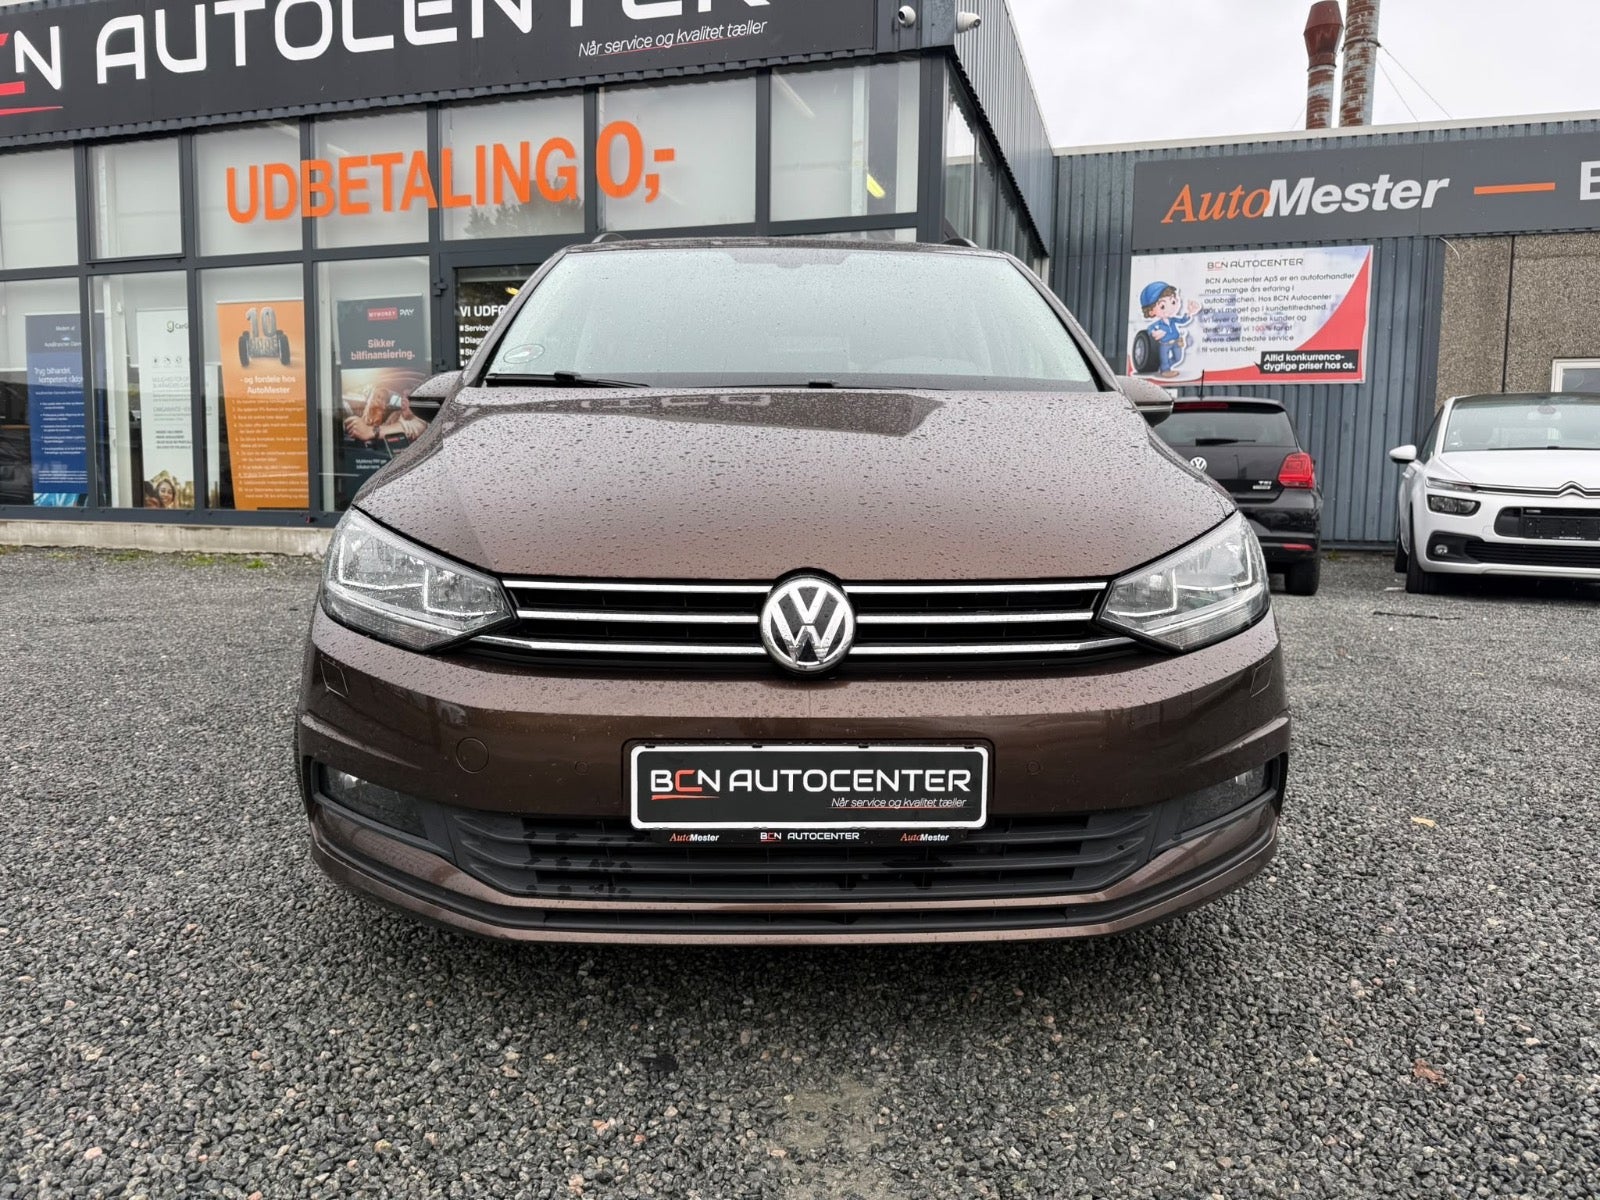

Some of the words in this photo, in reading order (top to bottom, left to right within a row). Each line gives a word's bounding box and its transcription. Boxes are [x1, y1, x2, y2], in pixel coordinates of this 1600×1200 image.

[578, 40, 602, 57] Når
[604, 34, 654, 54] service
[656, 34, 674, 49] og
[676, 24, 724, 43] kvalitet
[727, 19, 768, 38] tæller
[226, 137, 578, 224] UDBETALING
[1161, 173, 1450, 224] AutoMester
[1207, 261, 1229, 270] BCN
[1230, 258, 1304, 269] AUTOCENTER
[1222, 276, 1262, 284] Autocenter
[1300, 272, 1355, 281] autoforhandler
[1222, 287, 1249, 295] mange
[1250, 285, 1261, 293] års
[1262, 284, 1291, 294] erfaring
[1273, 294, 1289, 302] BCN
[1290, 294, 1332, 302] Autocenter
[459, 305, 471, 317] VI
[1240, 315, 1268, 323] tilfredse
[1269, 314, 1295, 322] kunder
[367, 338, 396, 349] Sikker
[1241, 334, 1267, 342] bedste
[1268, 334, 1294, 342] service
[351, 348, 416, 361] bilfinansiering.
[1264, 353, 1284, 362] Altid
[1285, 352, 1345, 362] konkurrence-
[1263, 362, 1297, 373] dygtige
[1298, 361, 1323, 371] priser
[1325, 361, 1341, 370] hos
[1342, 362, 1356, 370] os.
[254, 375, 282, 384] fordele
[282, 375, 296, 383] hos
[247, 386, 290, 395] AutoMester
[650, 769, 721, 793] BCN
[728, 769, 972, 793] AUTOCENTER
[831, 797, 849, 808] Når
[850, 798, 887, 808] service
[888, 799, 902, 809] og
[903, 797, 937, 808] kvalitet
[938, 797, 967, 808] tæller
[669, 832, 720, 843] AutoMester
[760, 832, 782, 841] BCN
[786, 832, 860, 841] AUTOCENTER
[900, 832, 950, 842] AutoMester
